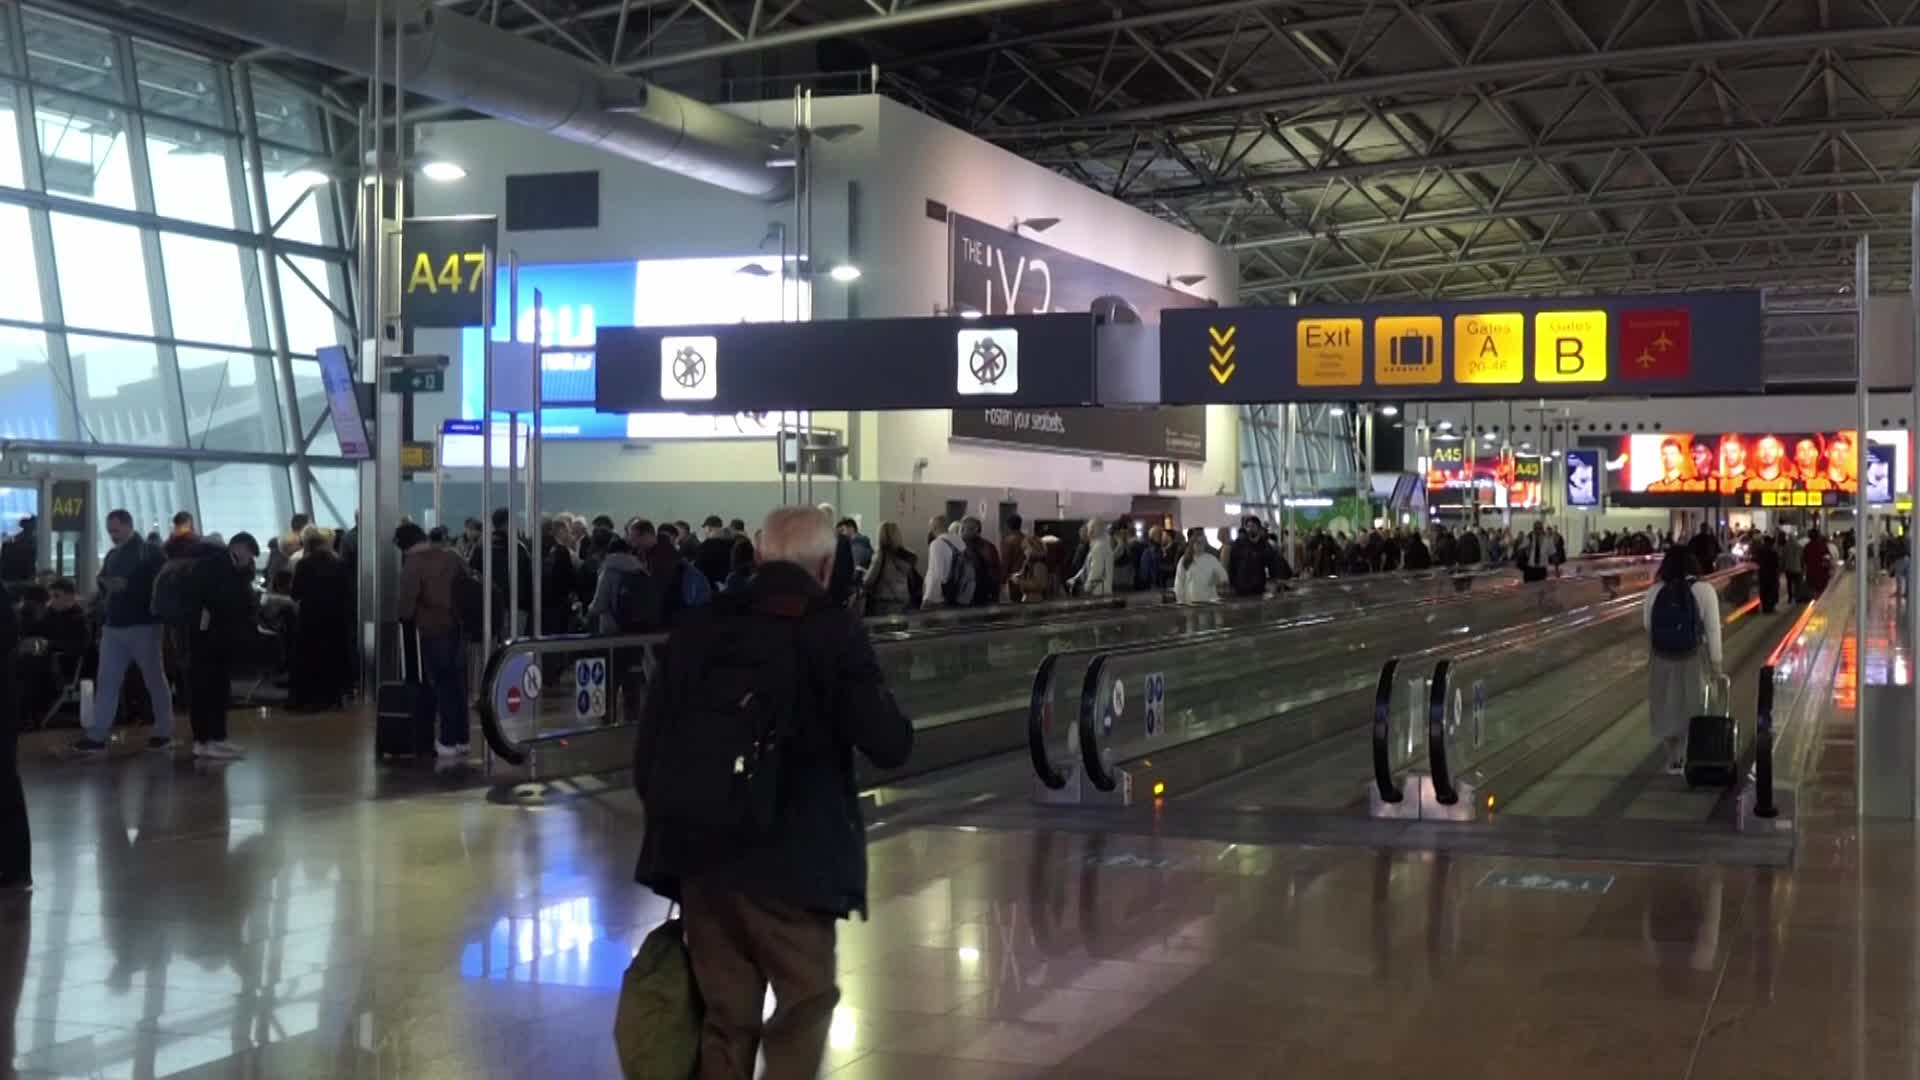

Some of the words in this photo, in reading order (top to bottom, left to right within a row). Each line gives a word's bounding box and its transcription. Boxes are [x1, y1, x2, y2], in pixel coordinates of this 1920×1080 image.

[962, 237, 983, 265] THE
[407, 252, 485, 293] A47
[1306, 325, 1351, 348] Exit
[1466, 319, 1512, 336] Gates
[1550, 319, 1593, 334] Gates
[1479, 334, 1498, 359] A
[1556, 336, 1585, 375] B
[1432, 447, 1463, 462] A45
[54, 496, 83, 516] A47
